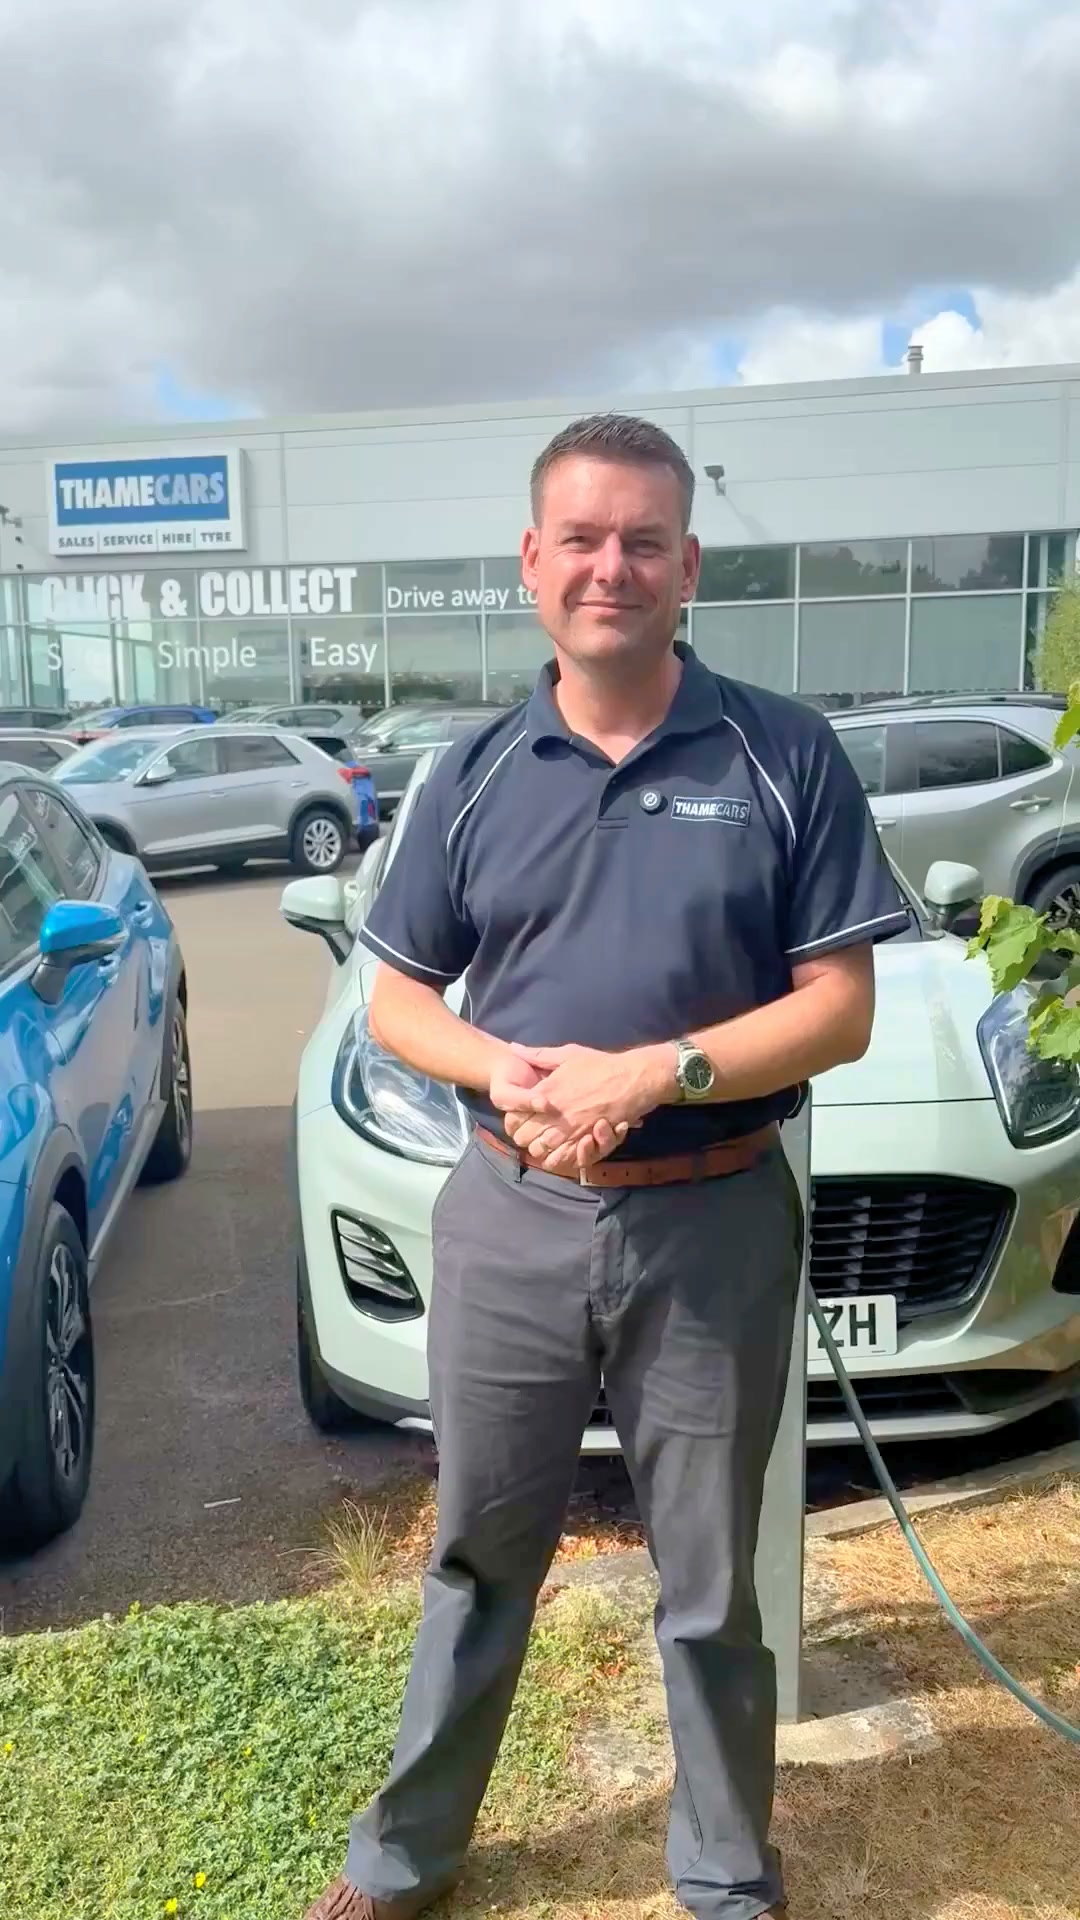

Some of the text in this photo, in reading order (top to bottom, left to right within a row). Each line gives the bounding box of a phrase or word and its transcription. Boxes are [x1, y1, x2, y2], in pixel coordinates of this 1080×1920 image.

[59, 471, 225, 510] THAMECARS
[58, 531, 232, 548] SALES SERVICE HIRE TYRE
[160, 579, 188, 617] &
[200, 567, 357, 617] COLLECT
[387, 585, 444, 609] Drive
[451, 587, 509, 610] away
[159, 637, 377, 673] Simple Easy
[675, 801, 748, 819] THAMECARS
